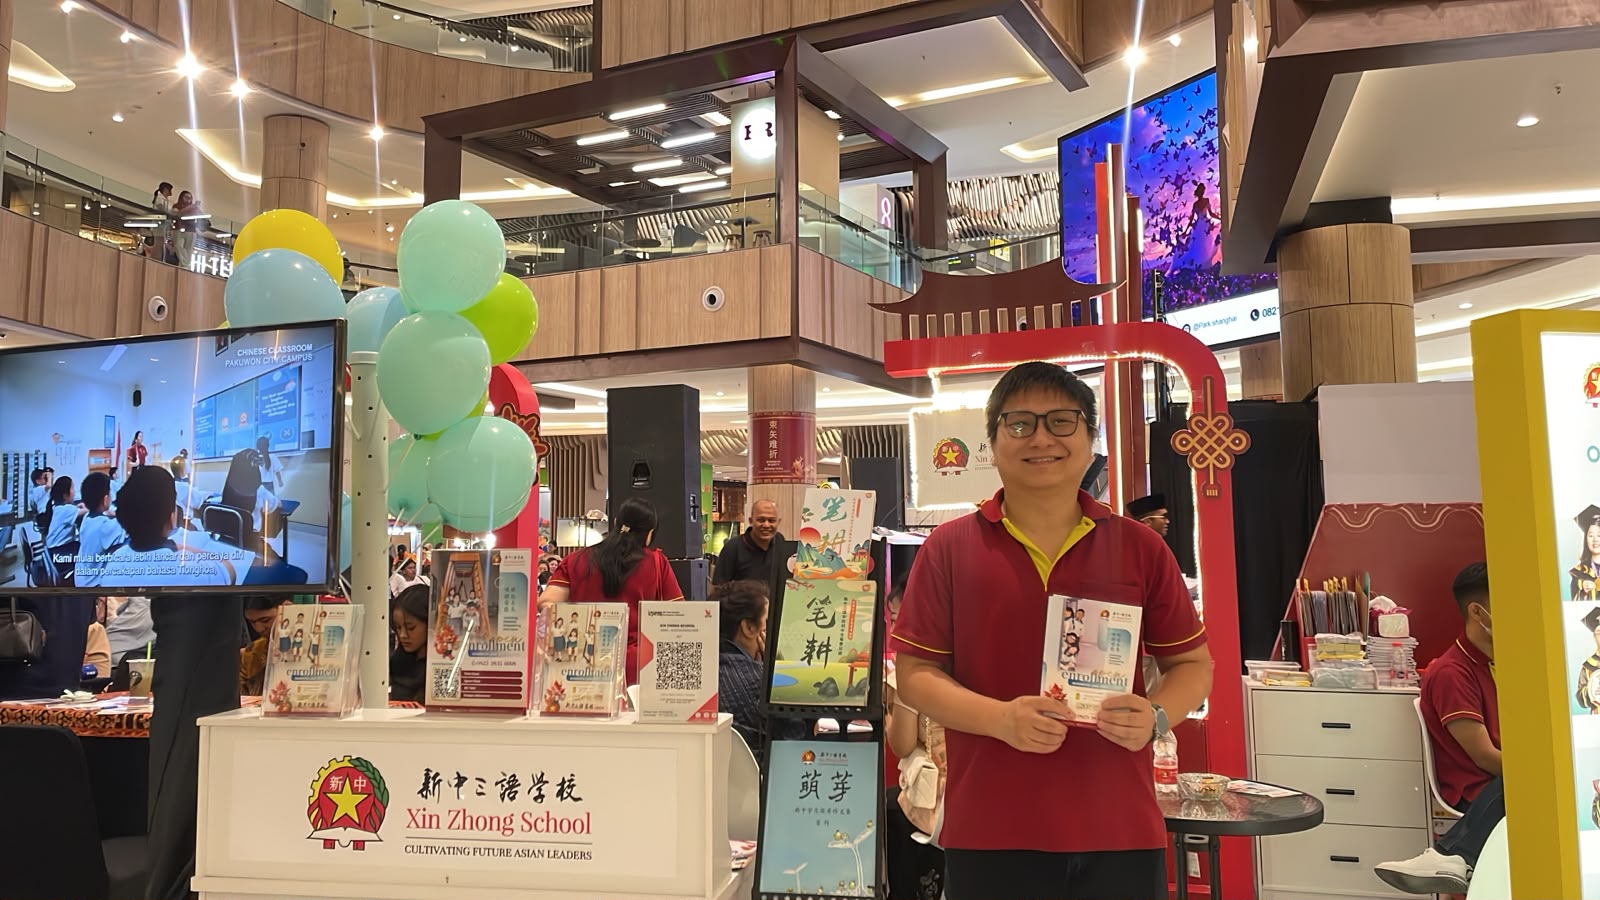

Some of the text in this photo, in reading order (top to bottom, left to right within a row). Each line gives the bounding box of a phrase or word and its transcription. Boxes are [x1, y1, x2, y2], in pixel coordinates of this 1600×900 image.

[1262, 306, 1279, 317] 082
[237, 347, 267, 356] CHINESE
[225, 358, 260, 367] PAKUWON
[281, 353, 313, 363] CAMPUS
[53, 553, 72, 563] Kami
[95, 552, 131, 562] berbicara
[133, 552, 152, 562] lebih
[153, 552, 178, 561] lancar
[197, 552, 229, 563] percaya
[76, 567, 98, 576] dalam
[100, 567, 145, 578] percakapan
[146, 565, 176, 575] bahasa
[467, 638, 525, 651] nrollment
[561, 666, 612, 677] enrollmen
[1061, 671, 1128, 686] enrollment
[329, 775, 367, 792] 新 中
[406, 808, 592, 837] Xin Zhong School
[404, 844, 592, 860] CULTIVATING FUTURE ASIAN LEADERS
